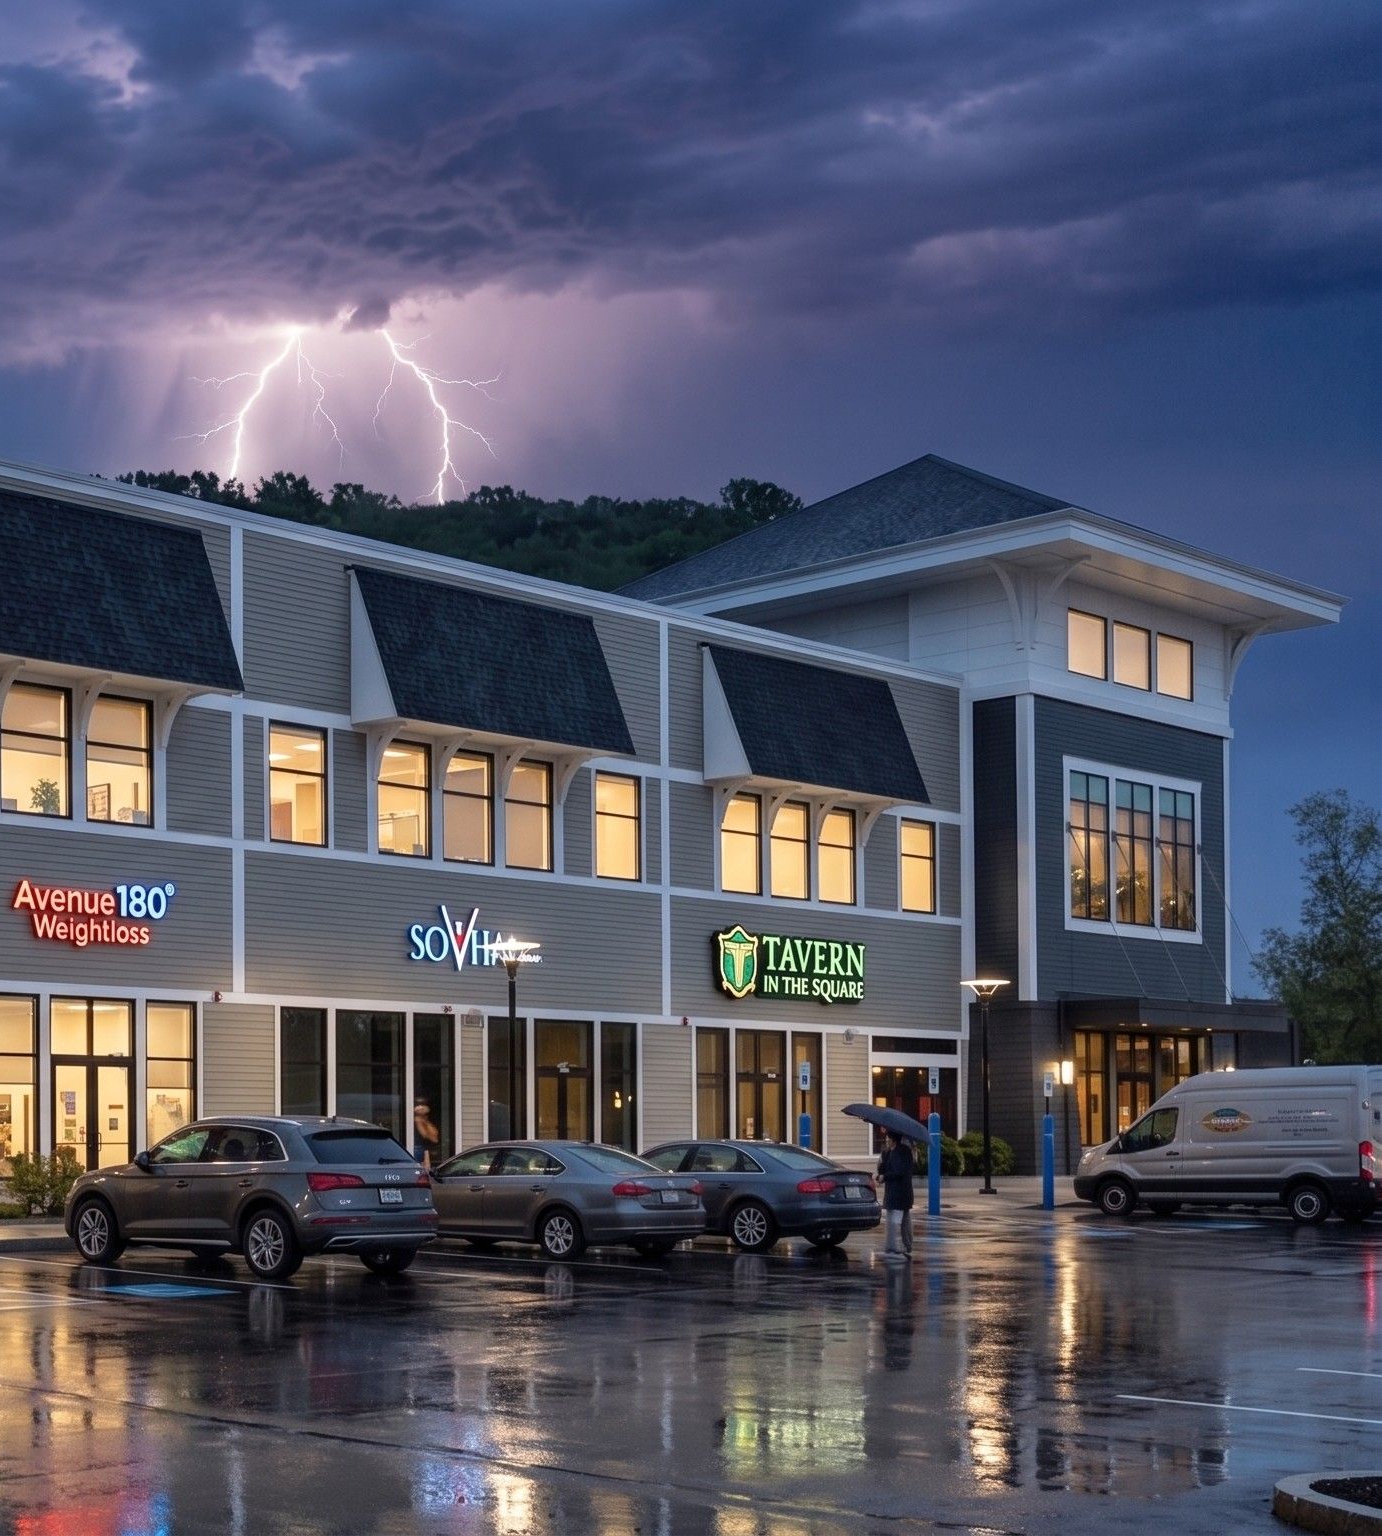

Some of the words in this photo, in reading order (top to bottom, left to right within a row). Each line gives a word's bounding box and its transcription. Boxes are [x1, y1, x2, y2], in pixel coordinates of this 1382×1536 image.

[33, 913, 150, 947] Weightloss
[762, 935, 866, 977] TAVERN
[763, 975, 779, 993] IN
[782, 976, 809, 996] THE
[812, 979, 864, 1003] SQUARE
